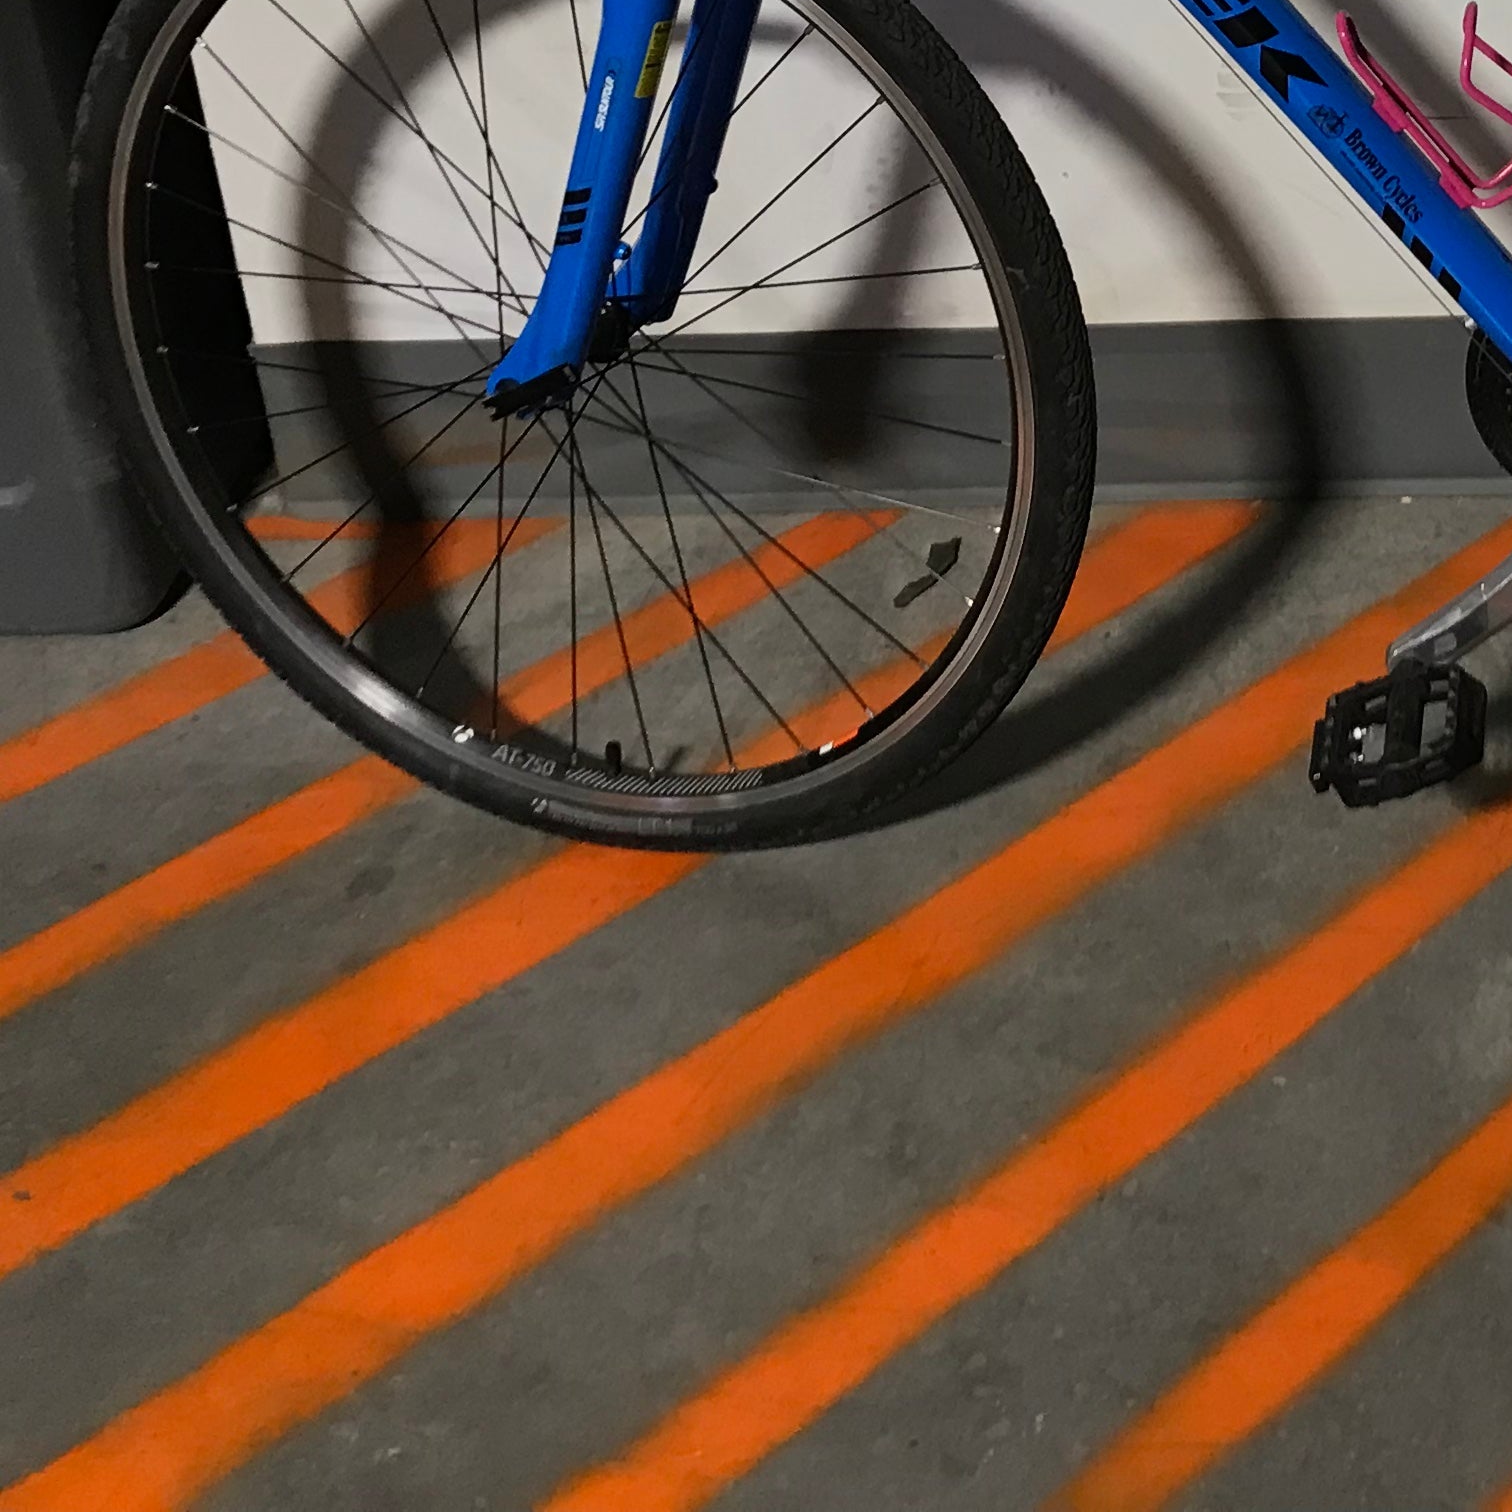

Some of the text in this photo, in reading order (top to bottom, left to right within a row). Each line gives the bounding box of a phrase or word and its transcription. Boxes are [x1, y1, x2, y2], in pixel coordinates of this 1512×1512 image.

[1344, 128, 1388, 181] Brown
[1382, 175, 1423, 224] Cycles
[491, 743, 557, 777] AT-750
